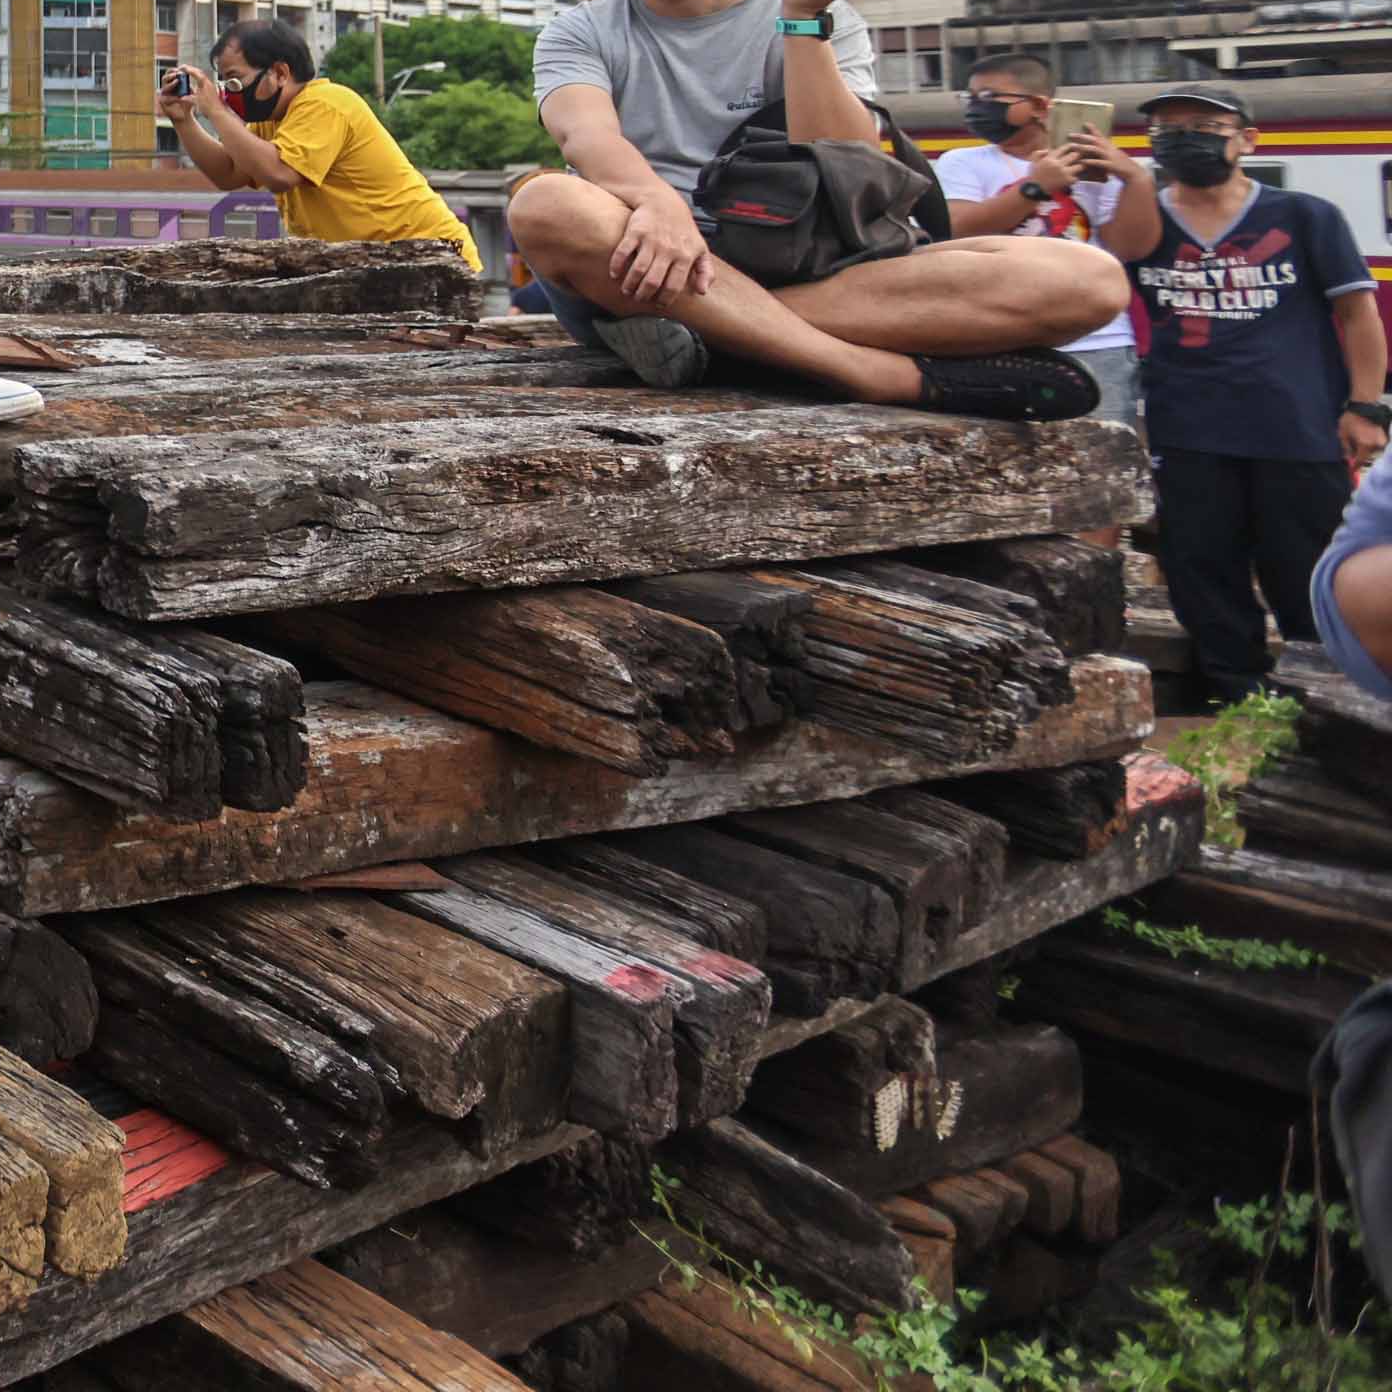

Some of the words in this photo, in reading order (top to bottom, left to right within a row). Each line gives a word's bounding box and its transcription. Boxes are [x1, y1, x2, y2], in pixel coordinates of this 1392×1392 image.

[1138, 266, 1225, 289] BEVERLY
[1228, 263, 1297, 288] HILLS
[1157, 289, 1216, 310] POLO
[1219, 288, 1278, 310] CLUB
